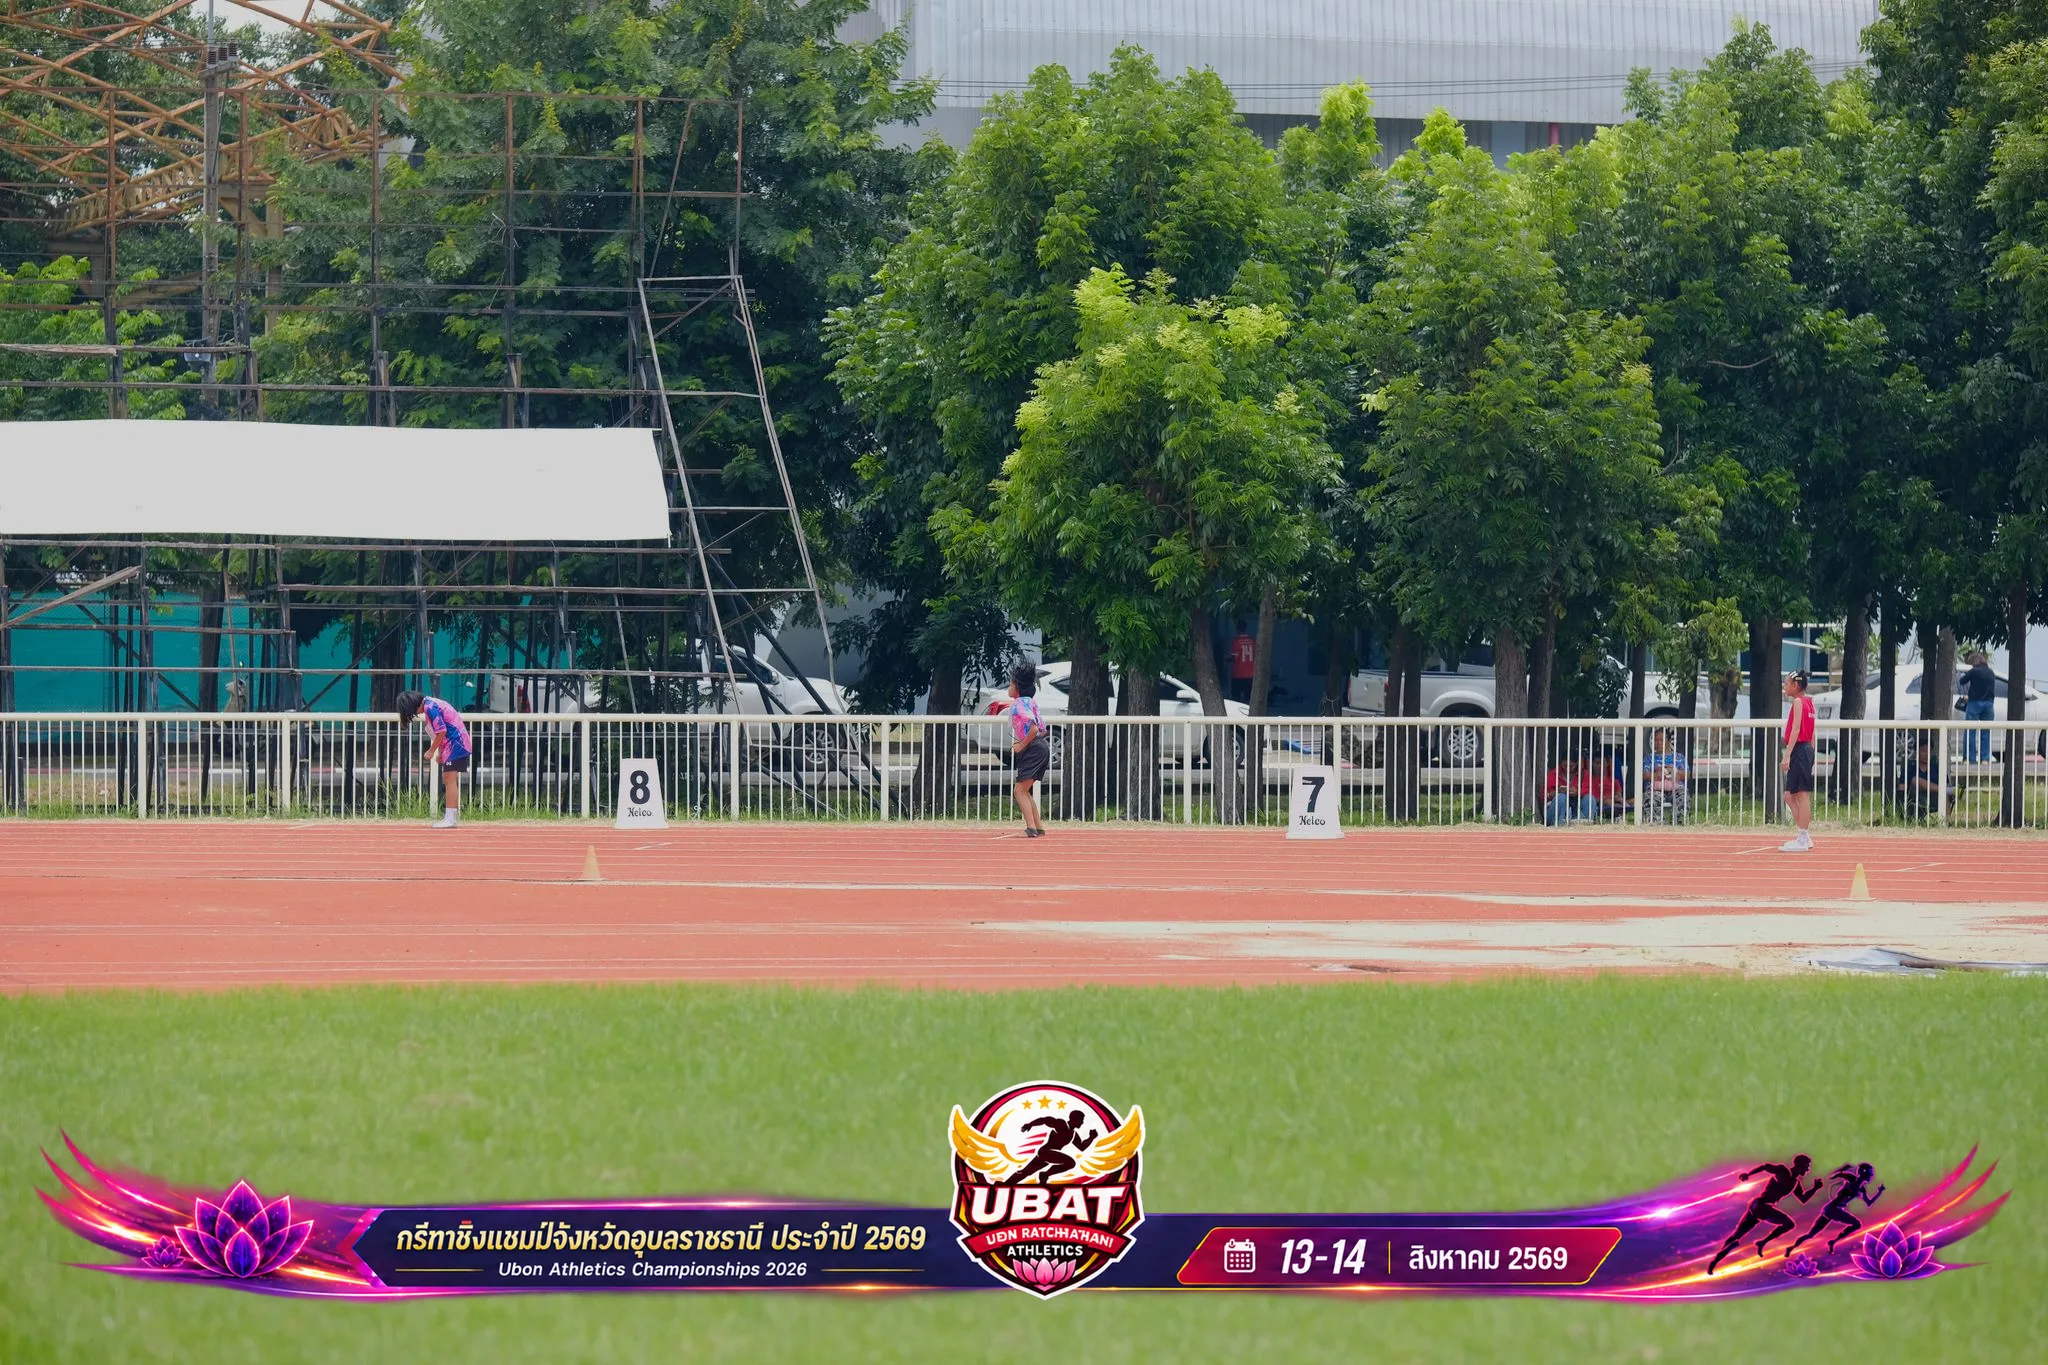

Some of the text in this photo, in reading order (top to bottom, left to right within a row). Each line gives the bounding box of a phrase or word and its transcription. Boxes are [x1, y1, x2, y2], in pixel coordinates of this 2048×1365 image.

[1240, 645, 1254, 663] 14
[629, 769, 651, 805] 8
[1301, 776, 1325, 813] 7
